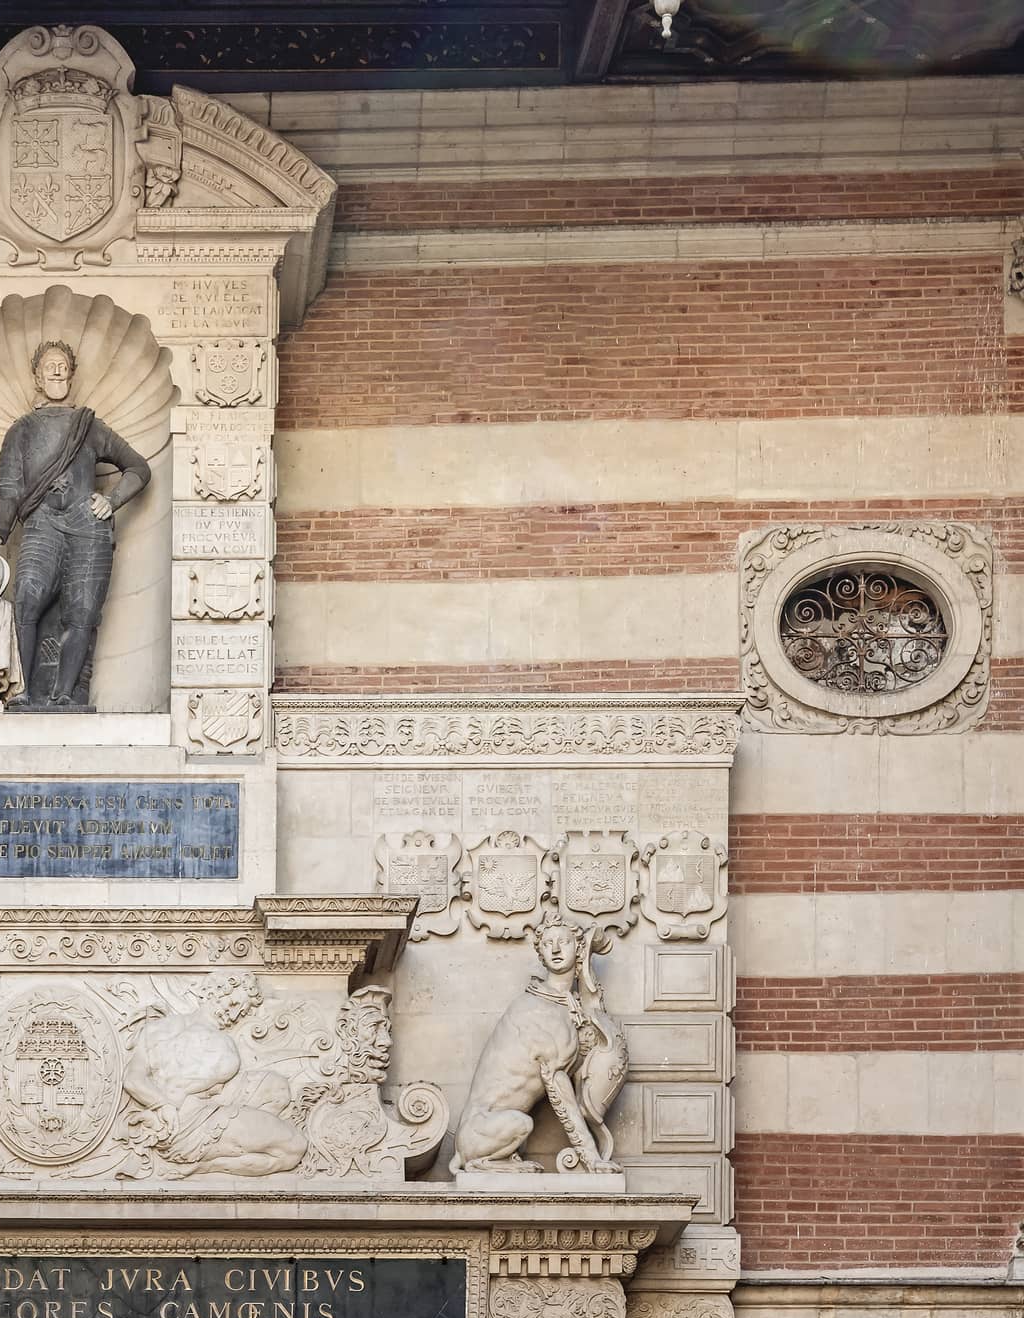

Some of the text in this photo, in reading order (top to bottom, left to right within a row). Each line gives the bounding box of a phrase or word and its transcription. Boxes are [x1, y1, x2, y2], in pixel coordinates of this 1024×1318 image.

[193, 280, 248, 289] HVVES
[203, 546, 219, 554] LA
[177, 649, 256, 660] REVELLAT
[176, 664, 258, 674] BOVRGEOIS
[14, 844, 40, 858] PIO
[47, 845, 112, 859] SEMPER
[3, 1267, 72, 1291] DAT
[99, 1268, 194, 1292] JVRA
[224, 1268, 367, 1292] CIVIBVS
